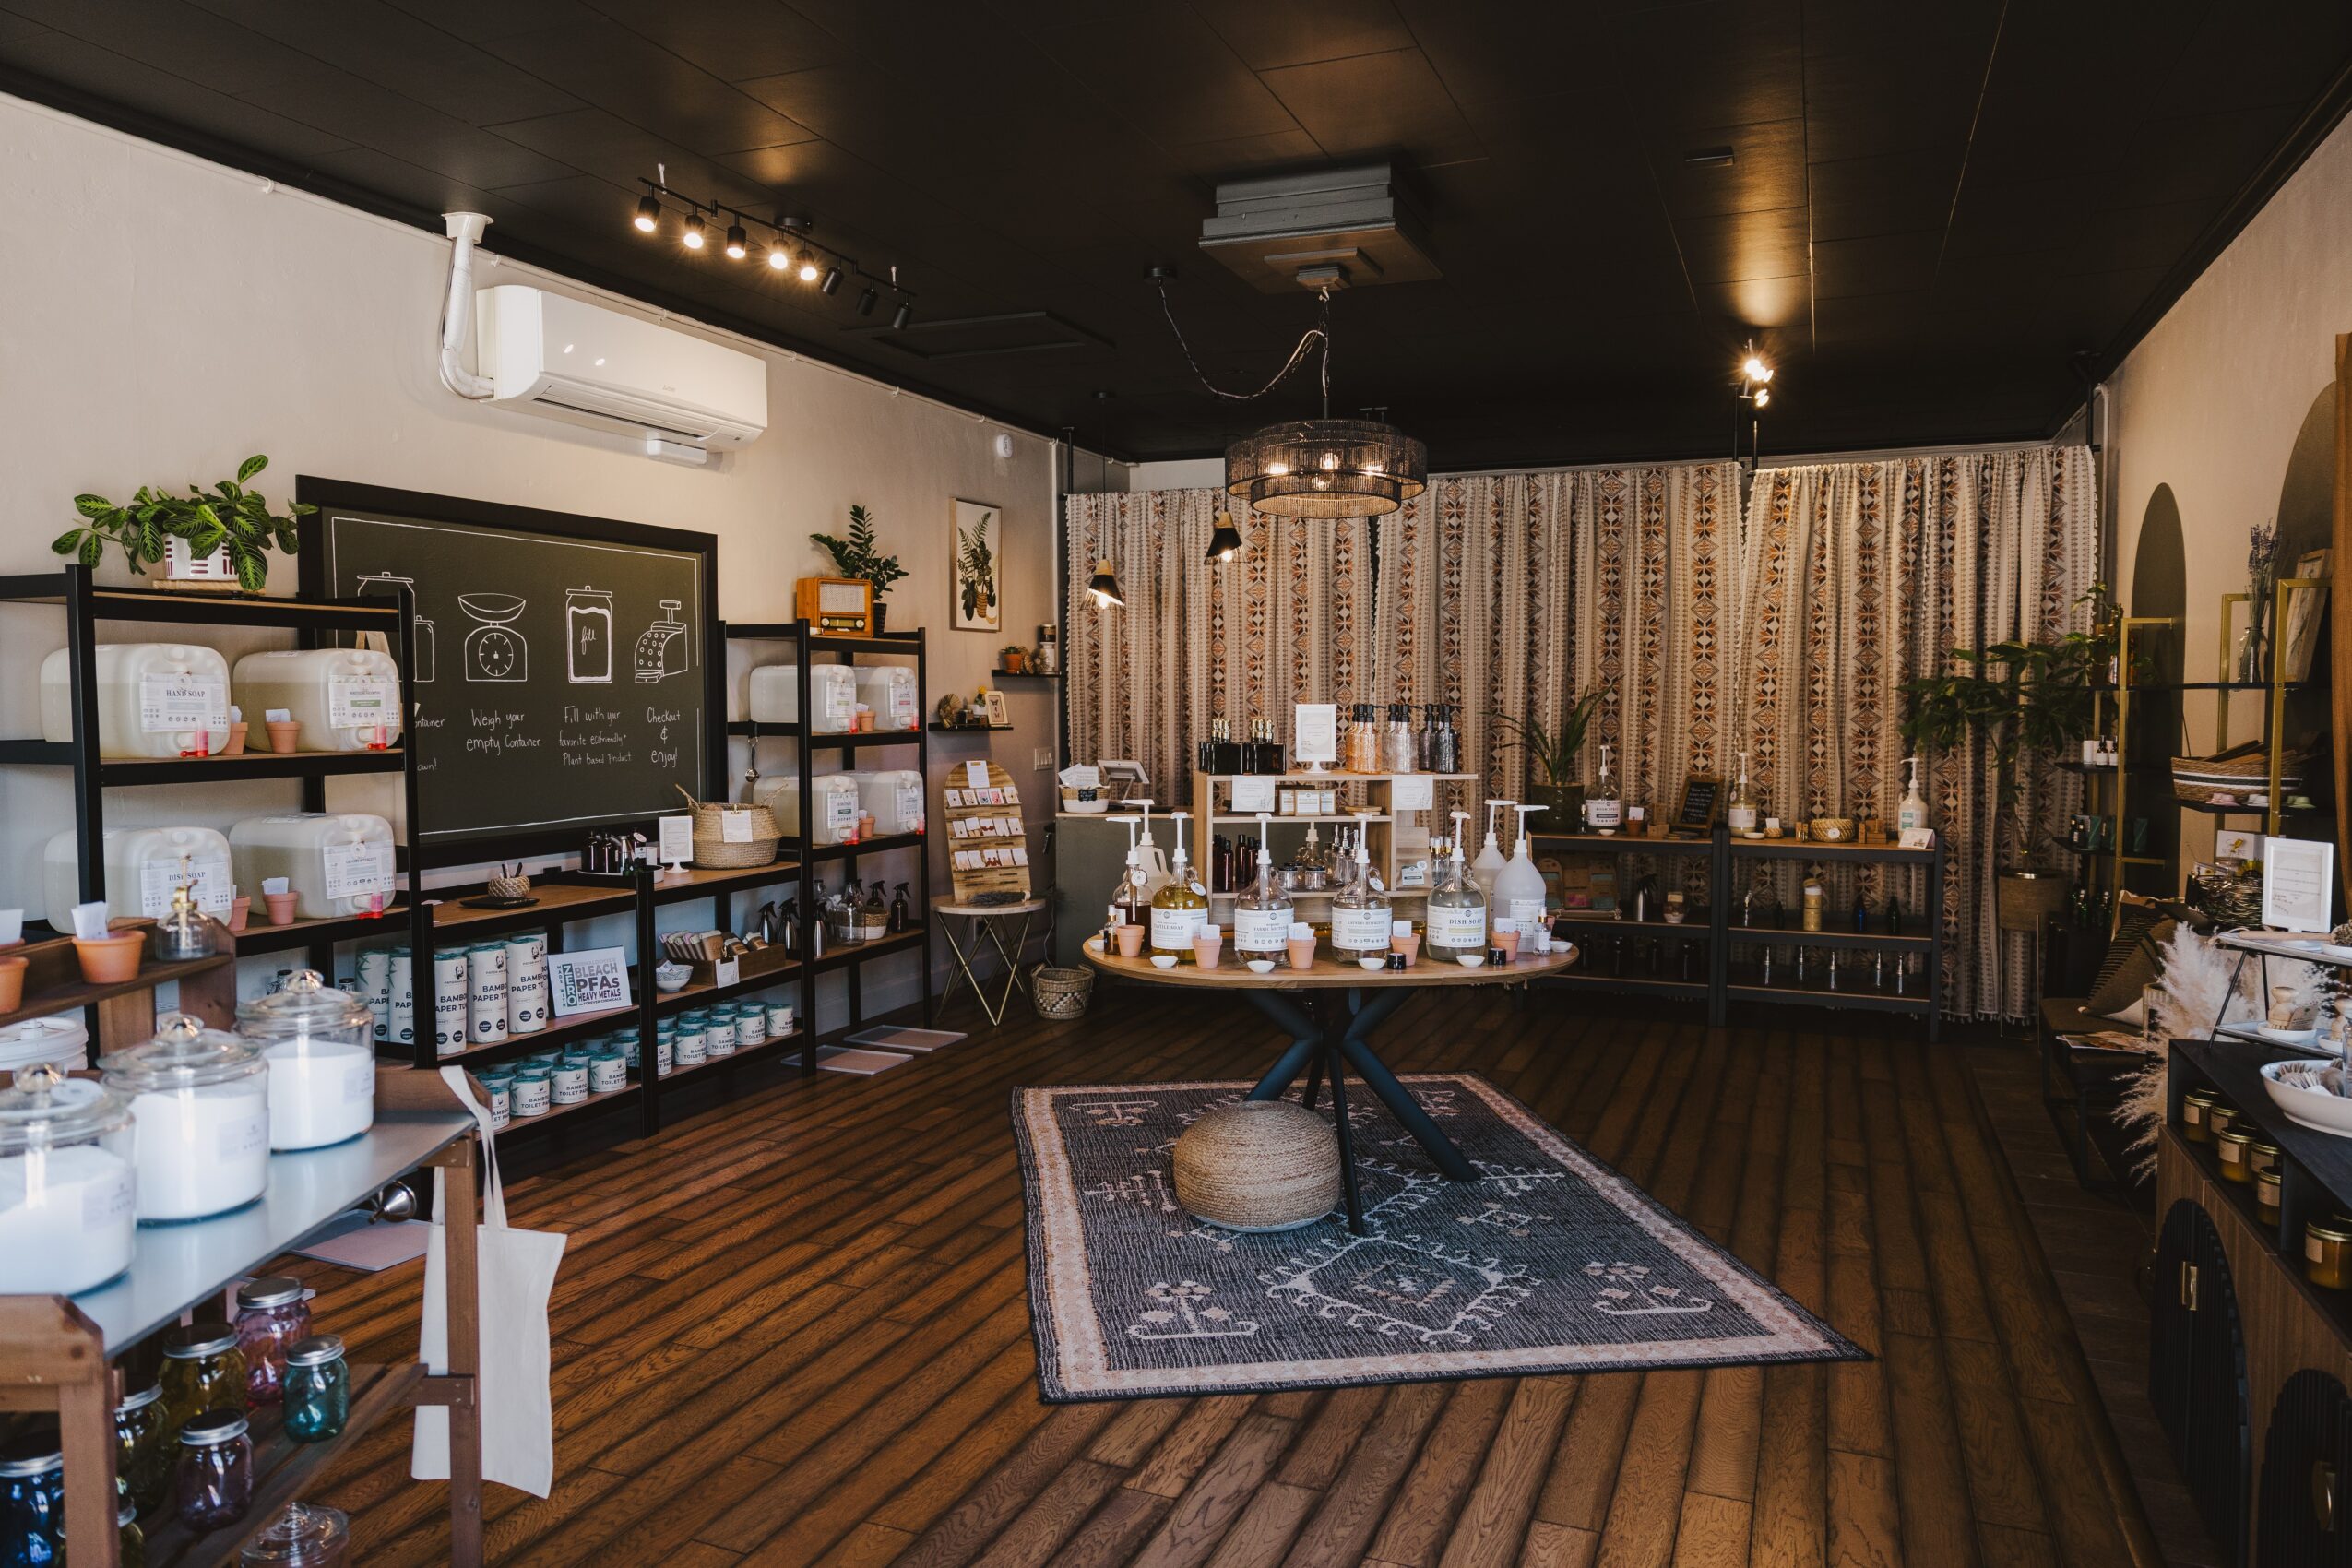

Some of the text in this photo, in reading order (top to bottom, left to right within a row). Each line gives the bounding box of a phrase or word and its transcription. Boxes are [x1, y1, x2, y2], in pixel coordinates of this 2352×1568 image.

[580, 625, 596, 655] fill
[166, 689, 186, 697] HAND
[188, 690, 205, 698] SOAP
[471, 708, 525, 731] Weigh your
[564, 706, 579, 723] Fill
[585, 707, 604, 721] with
[647, 707, 681, 724] Checkout
[466, 733, 542, 756] empty Container
[559, 729, 587, 747] favorite
[417, 757, 437, 771] own!
[563, 752, 582, 766] Plant
[586, 753, 604, 765] based
[651, 747, 678, 768] enjoy!
[574, 962, 618, 978] BLEACH
[511, 983, 537, 992] PAPER
[562, 965, 577, 1006] ZERO
[576, 975, 620, 993] PFAs
[472, 993, 499, 1003] PAPER
[577, 988, 621, 1002] HEAVY METALS
[435, 1004, 457, 1013] APER
